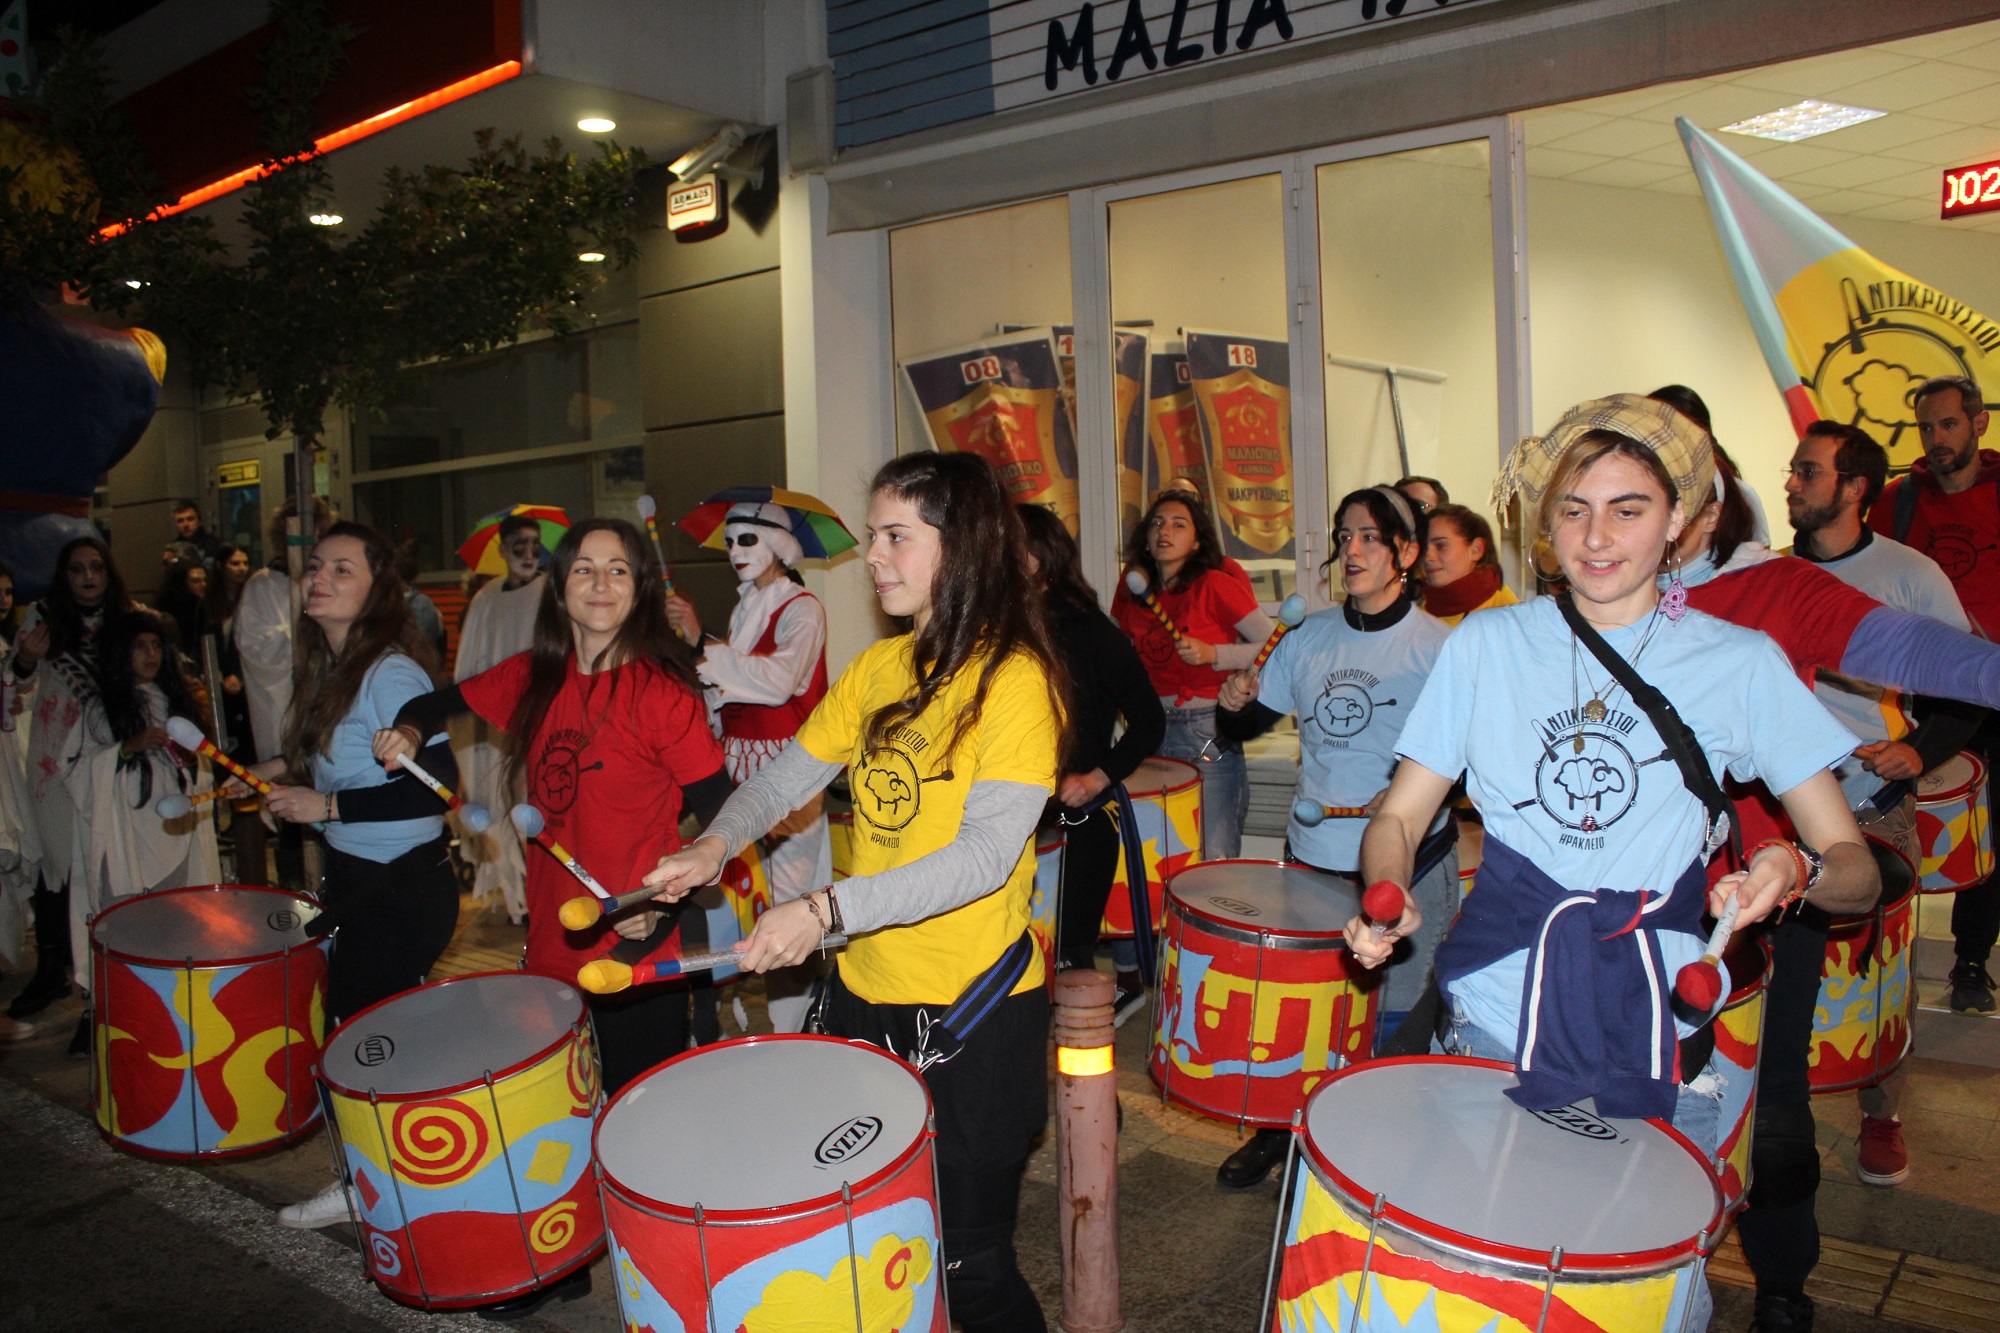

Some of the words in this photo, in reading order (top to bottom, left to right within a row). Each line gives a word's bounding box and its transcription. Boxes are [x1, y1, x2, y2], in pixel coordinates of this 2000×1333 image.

[1230, 345, 1256, 366] 18
[963, 357, 1000, 382] 08
[870, 831, 900, 849] ΗΡΑΚΛΕΙΟ
[1558, 833, 1605, 851] ΗΡΑΚΛΕΙΟ
[1541, 1107, 1608, 1136] ZZO
